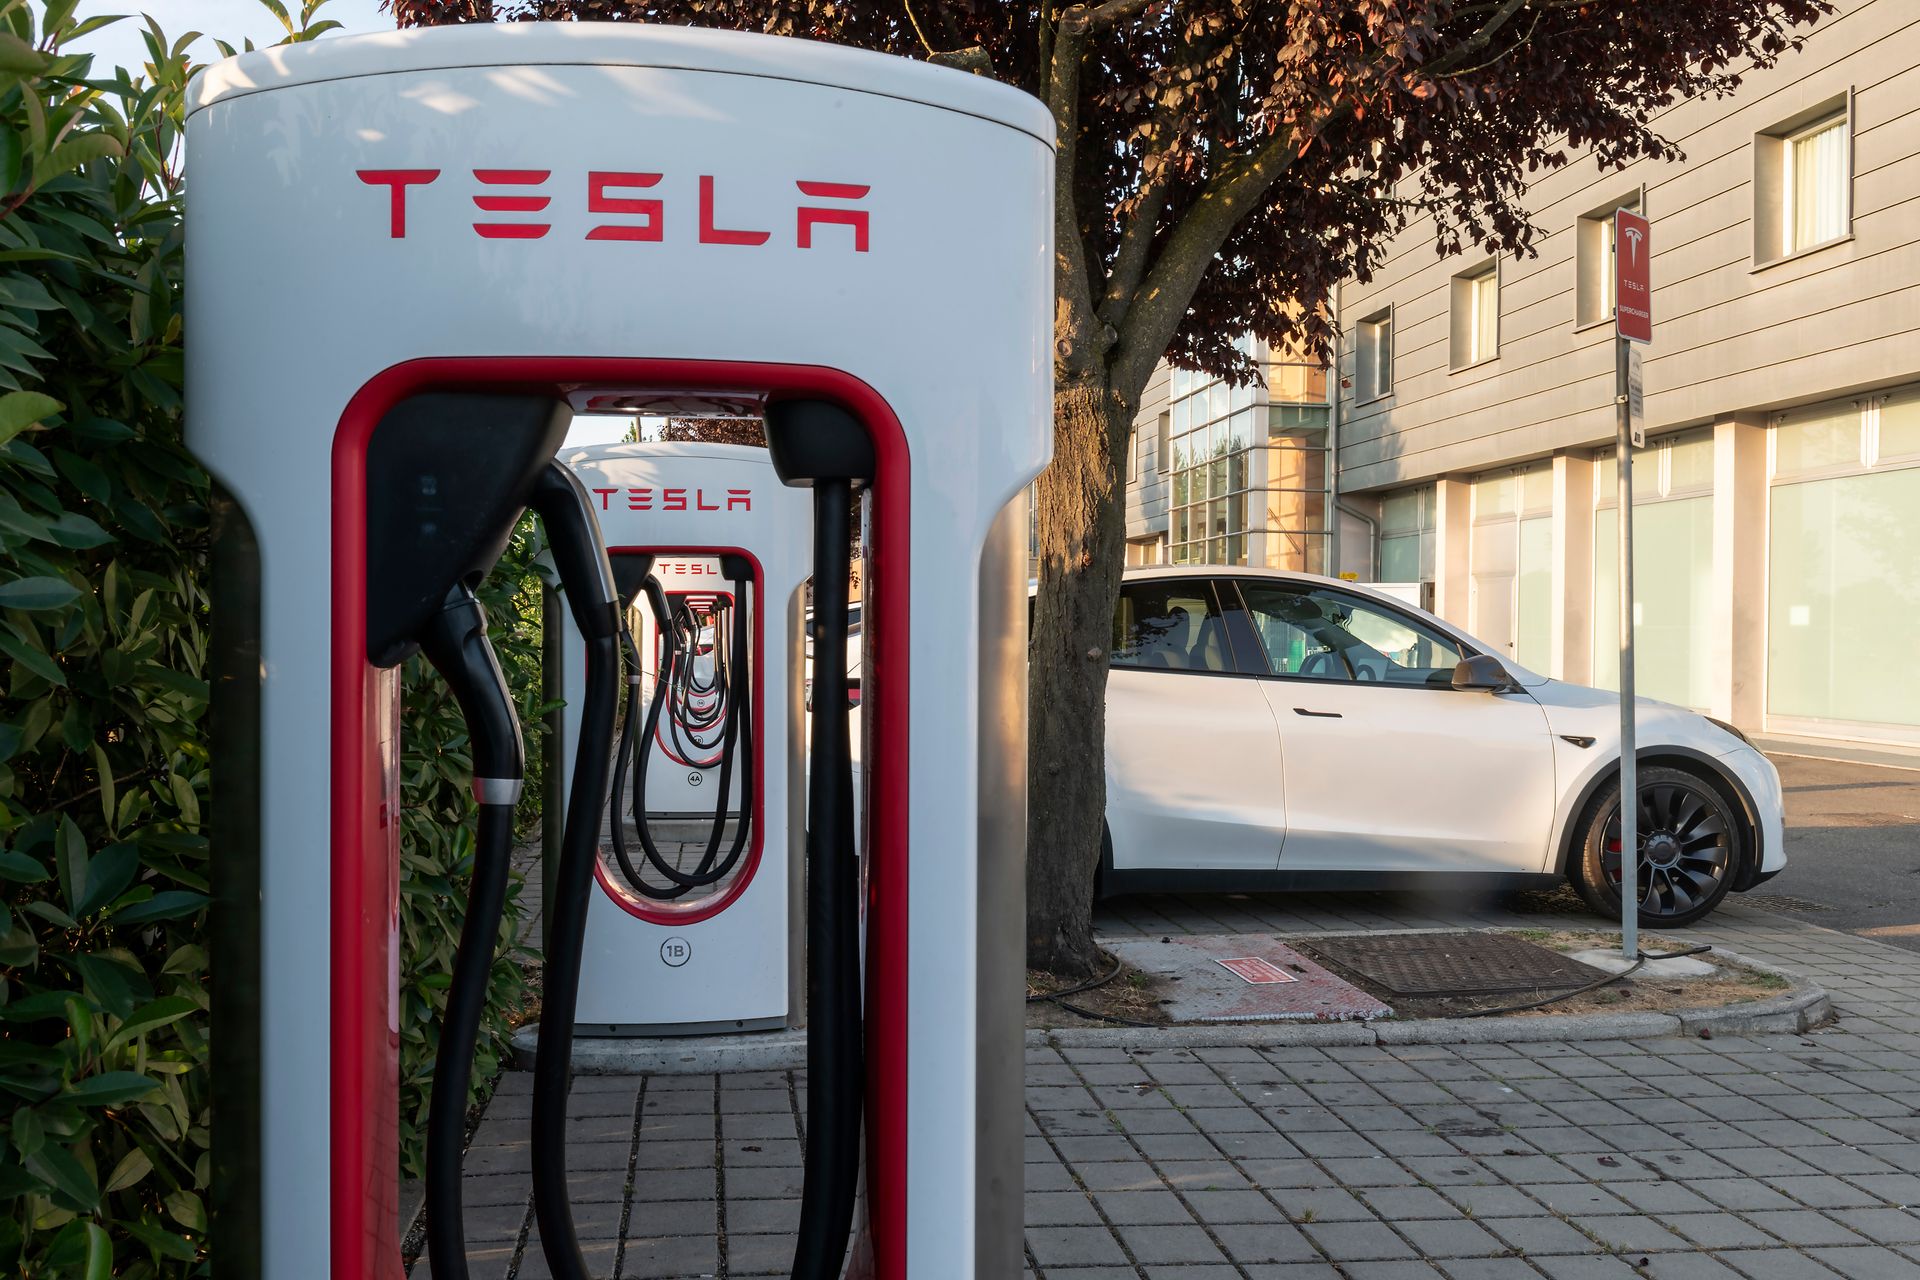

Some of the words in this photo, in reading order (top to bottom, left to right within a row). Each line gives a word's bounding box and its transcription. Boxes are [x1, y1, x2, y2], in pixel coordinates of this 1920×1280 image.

[356, 168, 871, 252] TESLA
[1623, 279, 1645, 292] TESLA
[592, 488, 751, 511] TESLA
[658, 563, 718, 575] TESL
[666, 945, 685, 957] 1B
